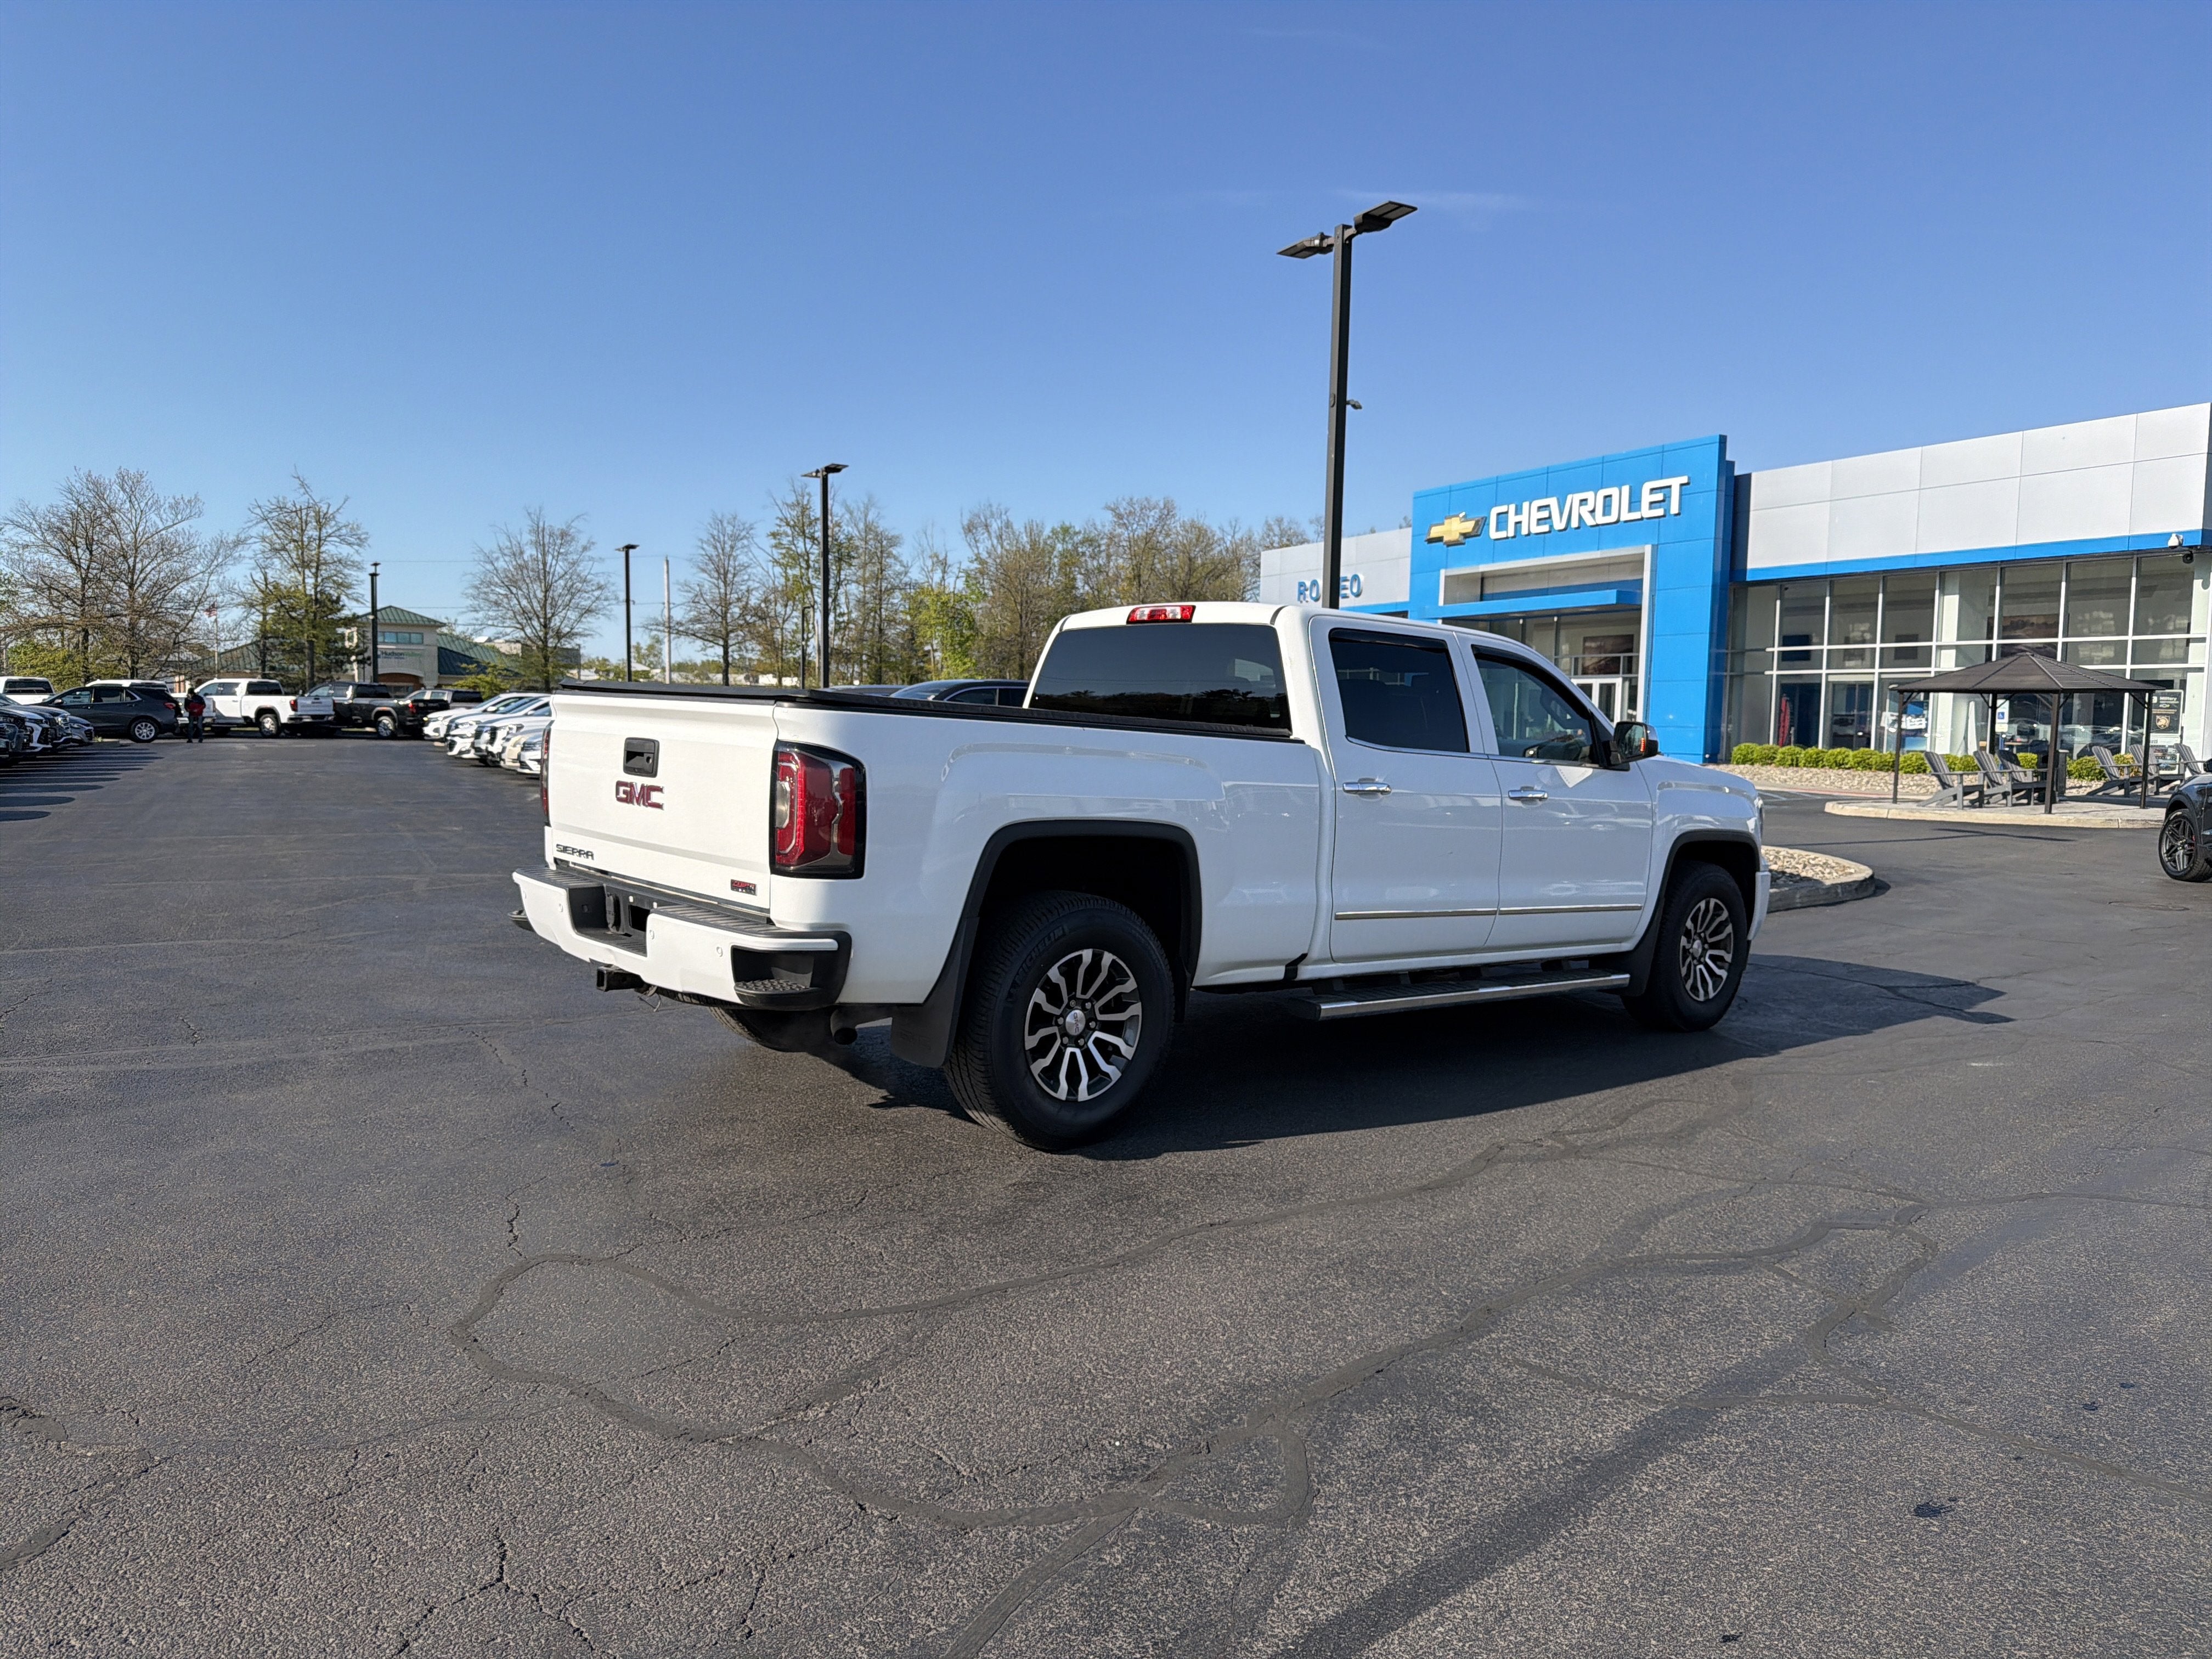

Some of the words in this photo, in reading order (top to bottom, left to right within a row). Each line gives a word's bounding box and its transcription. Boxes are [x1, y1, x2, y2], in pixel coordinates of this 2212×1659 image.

[1489, 475, 1690, 540] CHEVROLET
[1297, 573, 1363, 603] ROEO
[615, 780, 665, 811] GMC
[556, 843, 594, 861] SIERRA
[1014, 925, 1065, 985] MICHELIN
[1073, 1012, 1088, 1034] GMC
